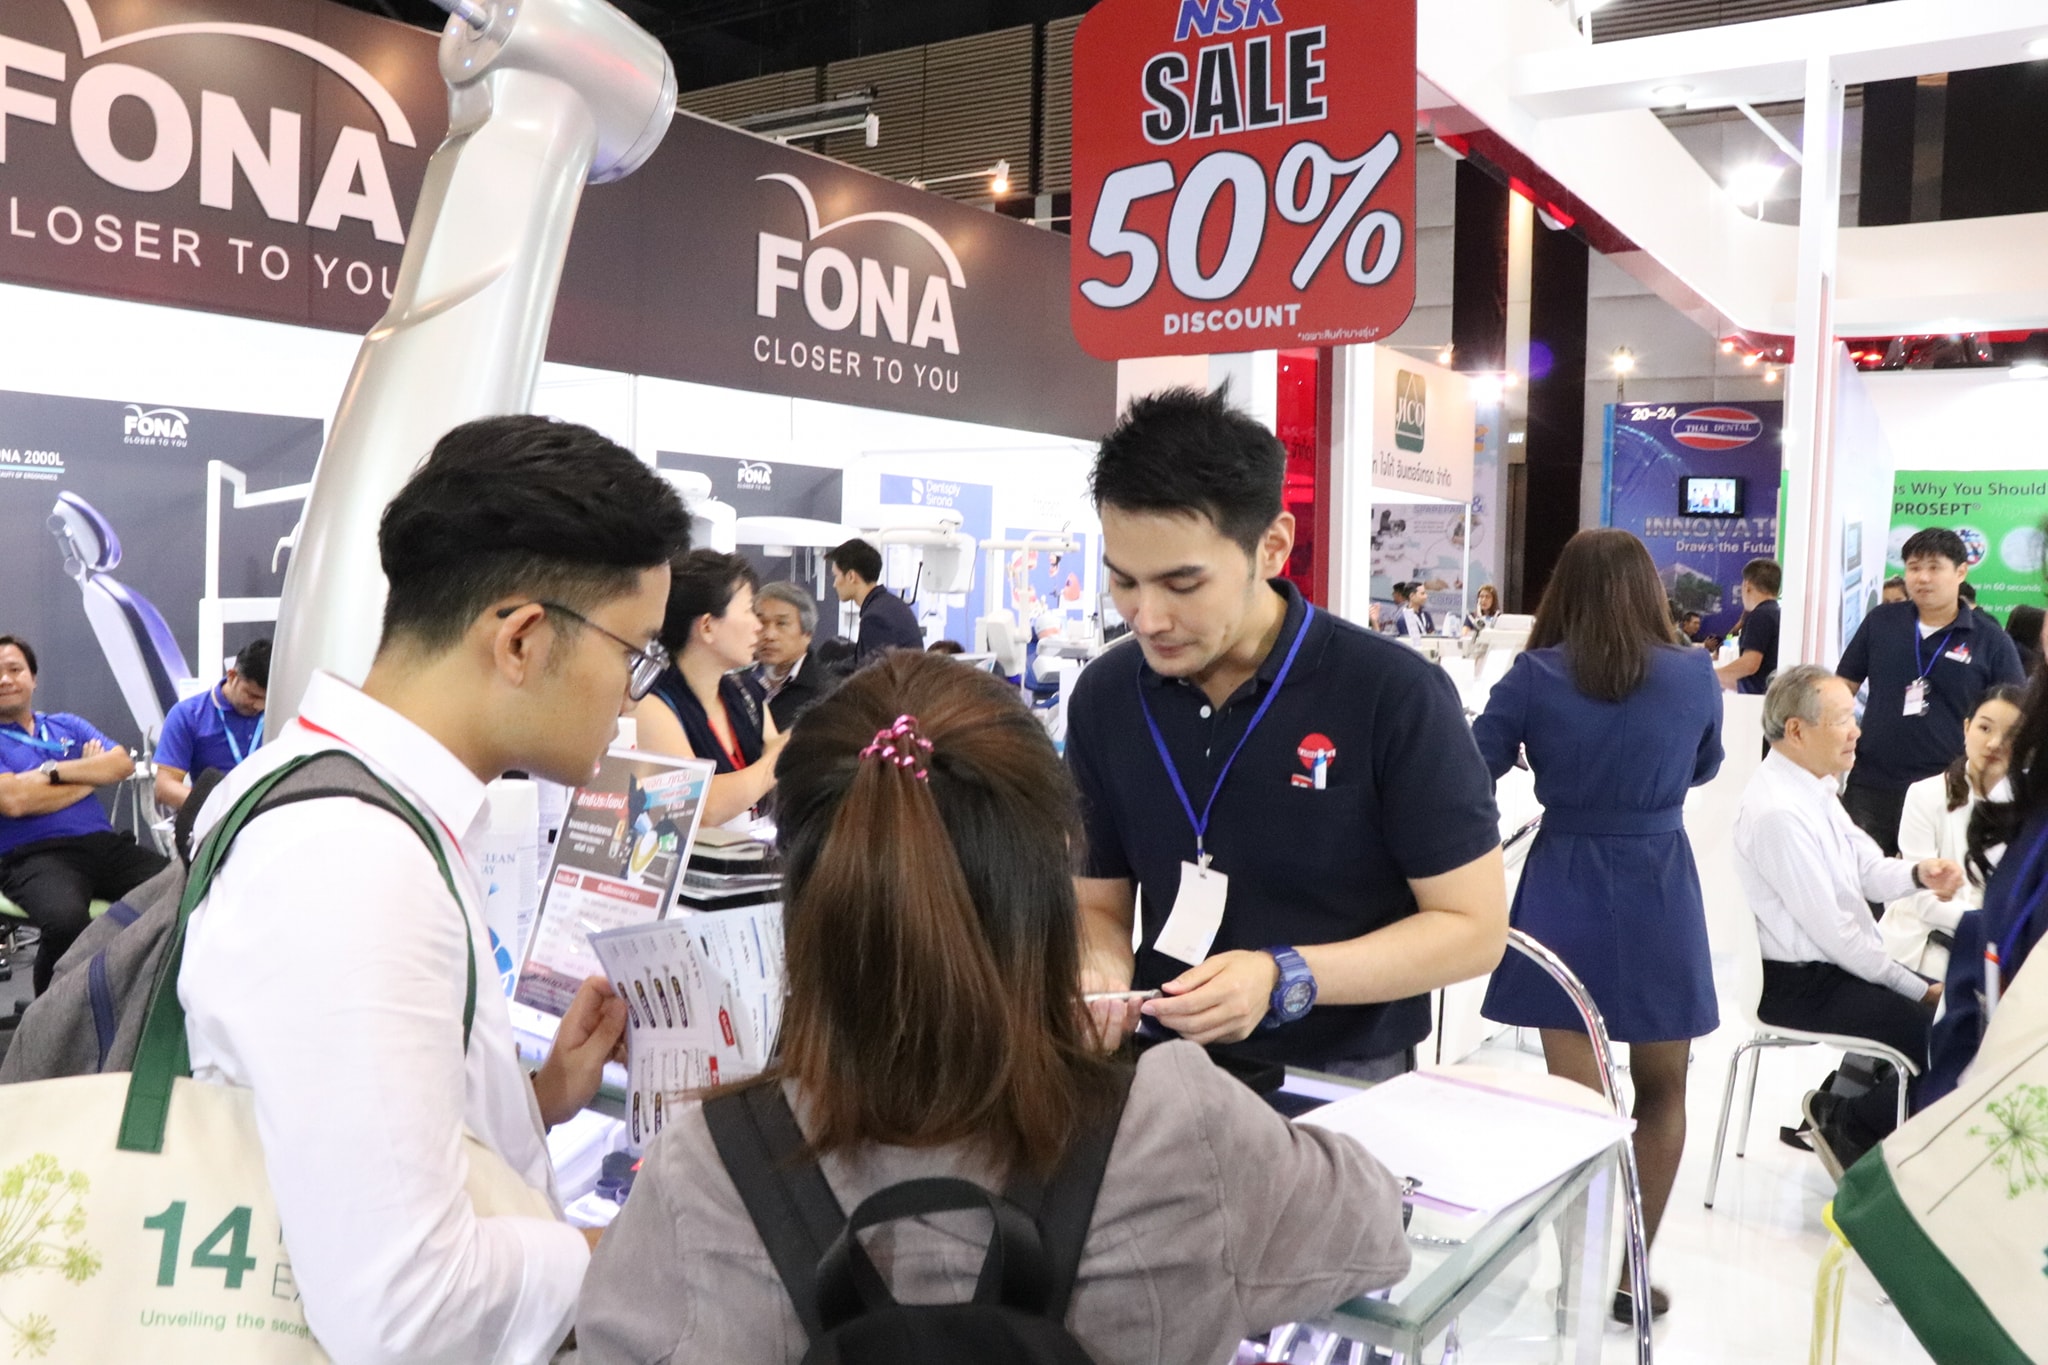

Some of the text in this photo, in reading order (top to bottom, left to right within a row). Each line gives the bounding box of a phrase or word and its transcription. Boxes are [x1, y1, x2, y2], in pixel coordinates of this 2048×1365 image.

[1173, 0, 1283, 42] NSK
[1142, 25, 1328, 146] SALE
[0, 34, 405, 244] FONA
[1079, 131, 1403, 310] 50%
[10, 197, 201, 267] LOSER
[228, 239, 290, 280] TO
[756, 231, 960, 355] FONA
[1163, 303, 1302, 336] DISCOUNT
[754, 335, 960, 393] CLOSER TO YOU
[1631, 407, 1677, 421] 20-24
[124, 415, 188, 439] FONA
[1685, 423, 1751, 432] THAI DENTAL
[123, 436, 188, 448] CLOSER TO YOU
[0, 449, 64, 466] NA 2000L
[737, 468, 771, 485] FONA
[926, 479, 961, 498] Dentsply
[1911, 482, 1947, 498] Why
[1953, 482, 1982, 495] You
[1988, 482, 2047, 495] Should
[1676, 541, 1714, 552] Draws
[1719, 541, 1739, 552] the
[1993, 582, 2006, 591] 60
[2006, 584, 2041, 592] seconds
[484, 853, 516, 864] LEAN
[143, 1200, 257, 1289] 14
[140, 1310, 226, 1331] Unveiling
[236, 1313, 265, 1329] the
